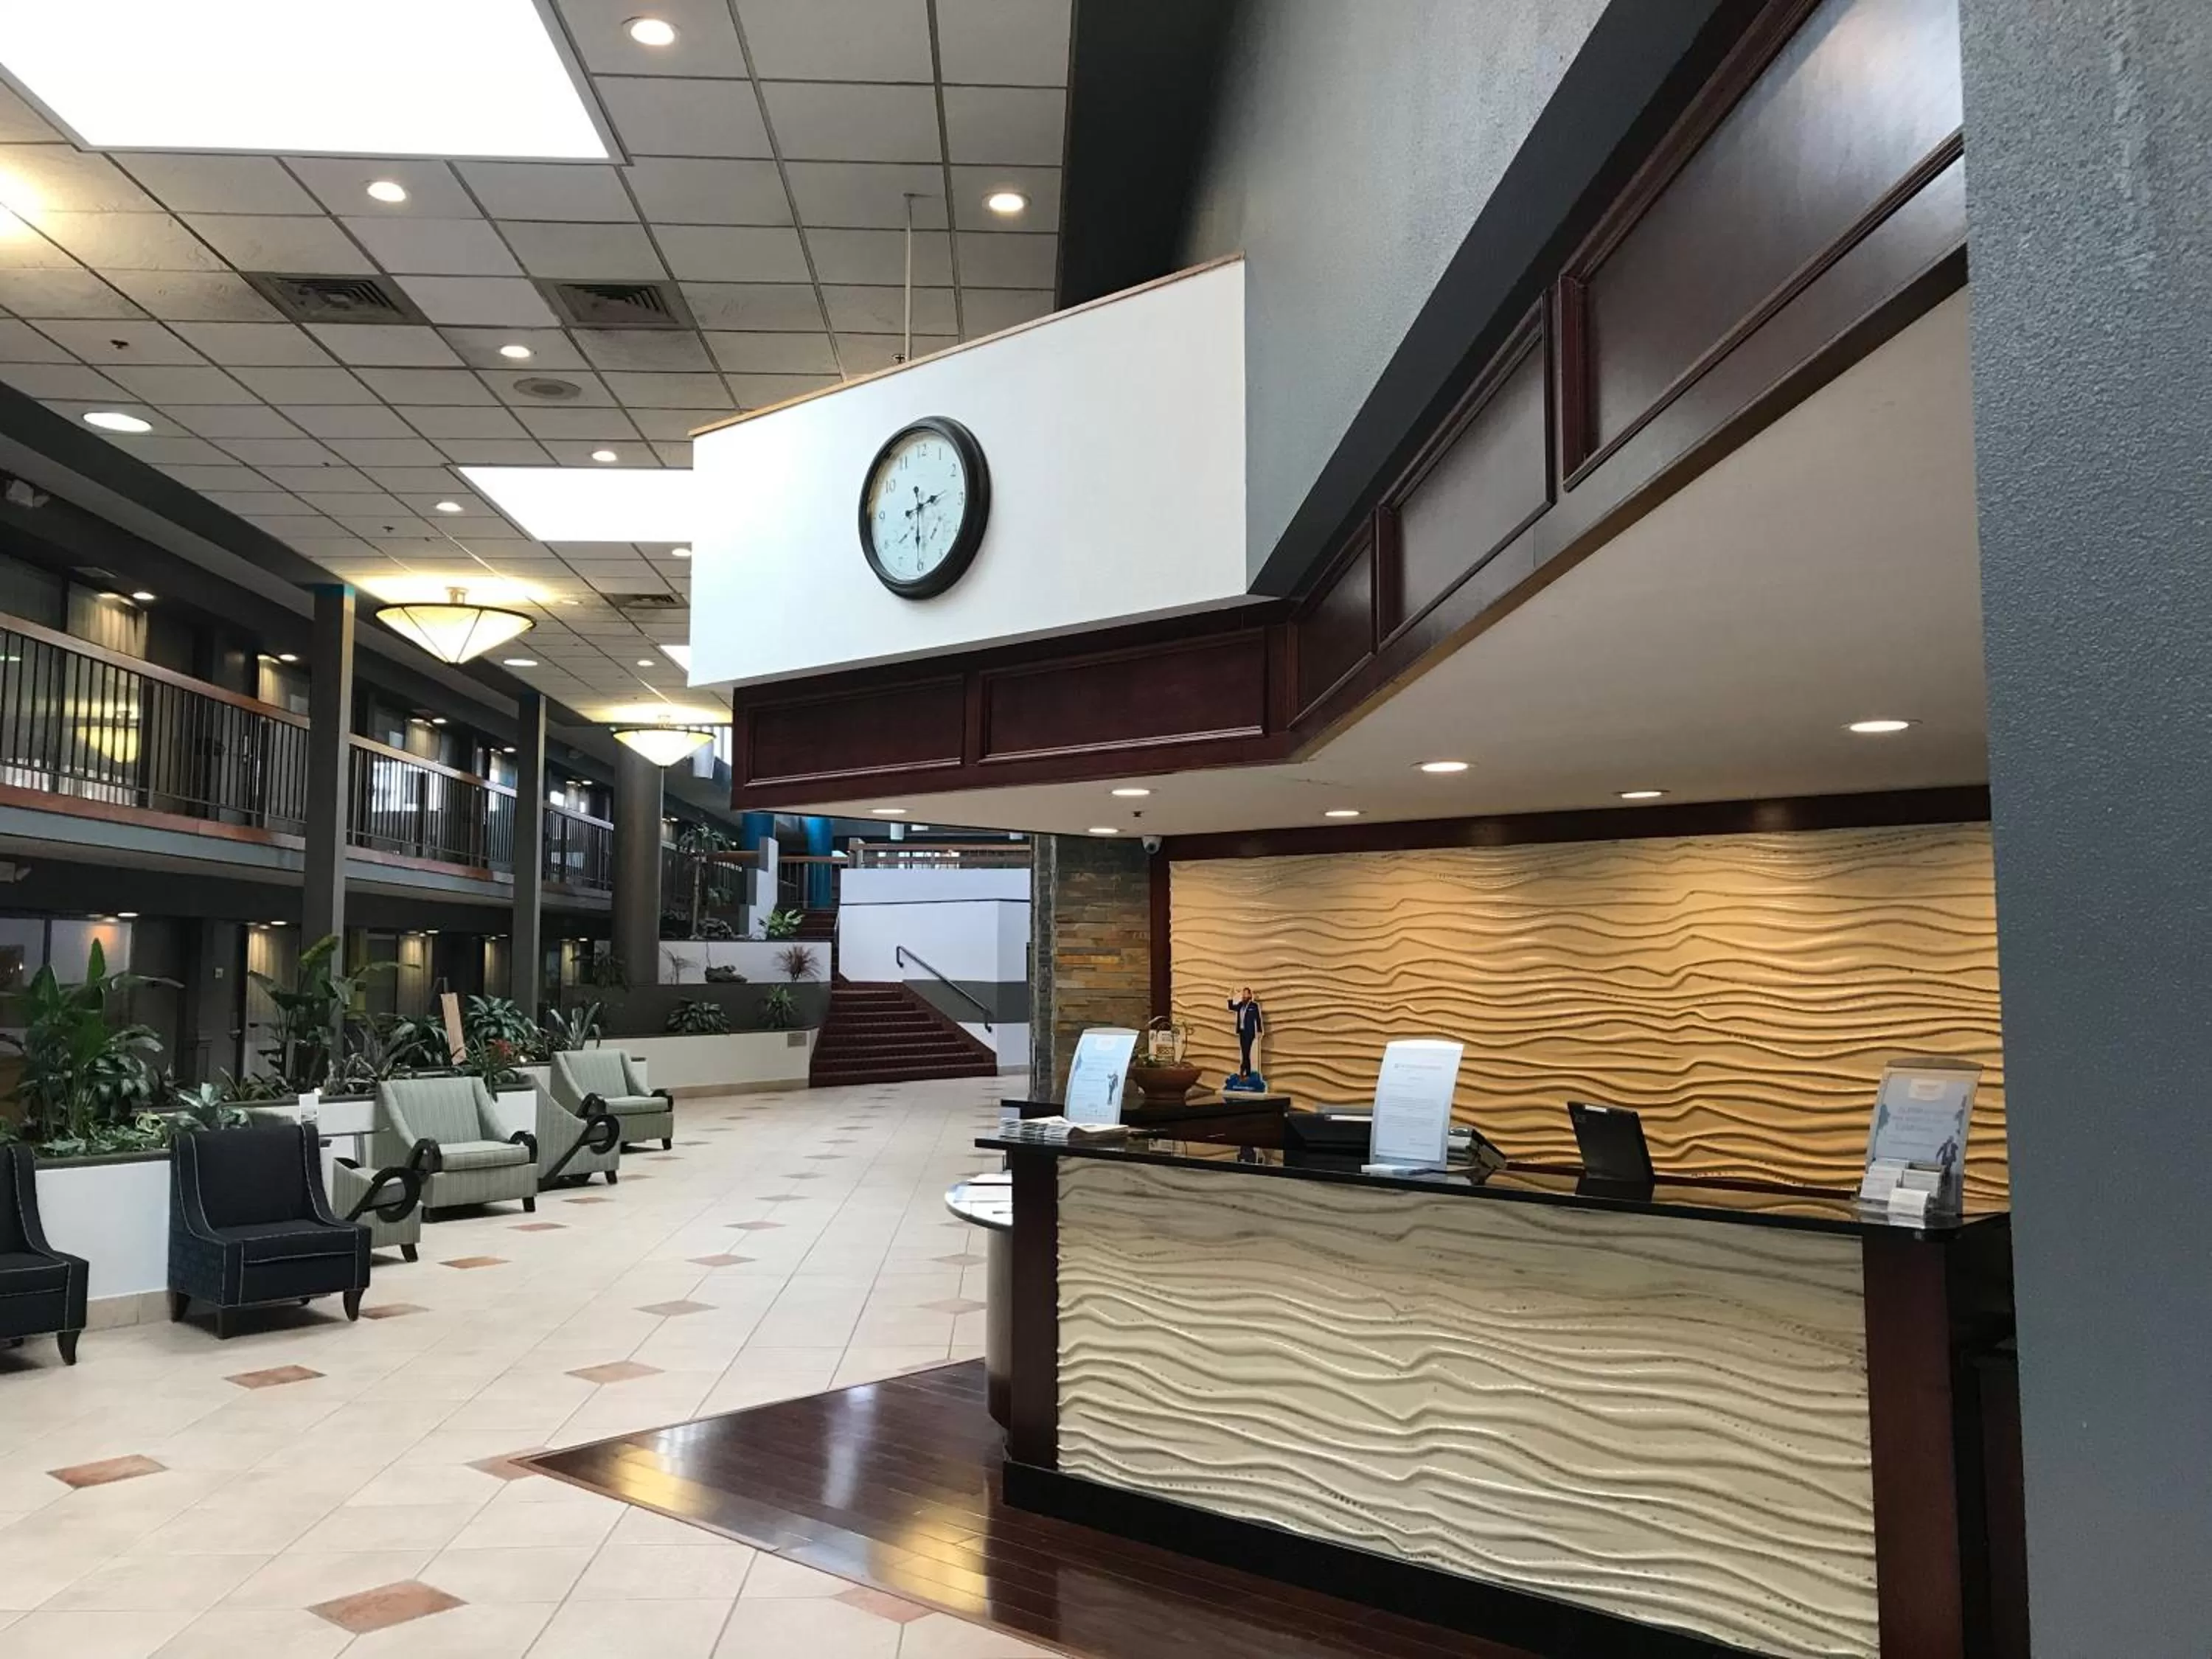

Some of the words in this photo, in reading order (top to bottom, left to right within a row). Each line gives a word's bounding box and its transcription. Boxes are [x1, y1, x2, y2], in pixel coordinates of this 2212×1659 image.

[917, 444, 927, 458] 12
[899, 456, 908, 470] 11
[950, 463, 957, 477] 2
[885, 479, 897, 494] 10
[957, 491, 964, 507] 3
